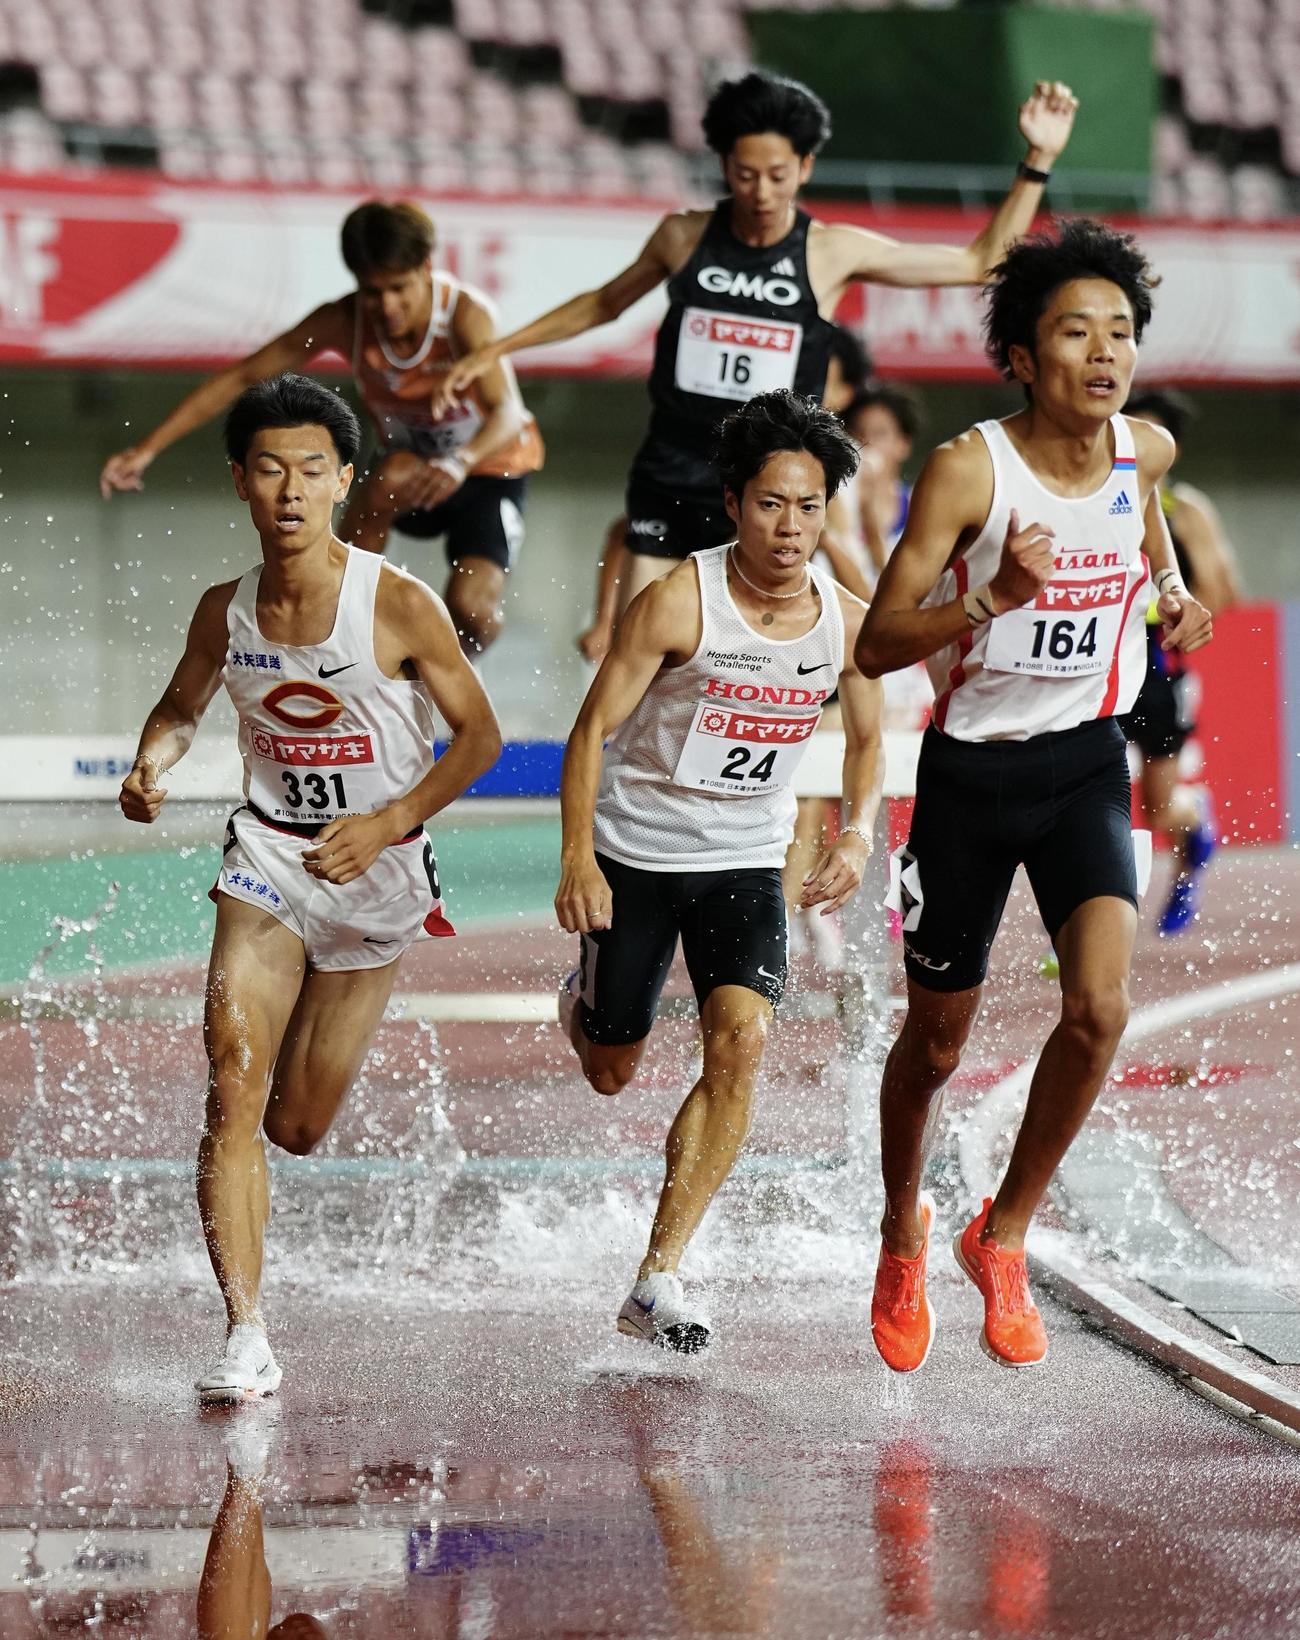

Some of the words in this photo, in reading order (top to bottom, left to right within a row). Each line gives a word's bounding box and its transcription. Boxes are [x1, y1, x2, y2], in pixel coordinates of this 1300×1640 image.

[697, 265, 801, 307] GMO
[714, 320, 790, 349] ヤマザキ
[719, 352, 752, 385] 16
[1108, 505, 1133, 516] adidas
[1054, 547, 1123, 570] isan
[1043, 579, 1123, 606] ヤマザキ
[1031, 616, 1098, 660] 164
[233, 651, 282, 670] 大矢運送
[706, 650, 738, 661] Honda
[738, 653, 772, 664] Sports
[713, 660, 762, 672] Challenge
[703, 679, 827, 705] HONDA
[734, 719, 815, 739] ヤマザキ
[276, 741, 366, 761] ヤマザキ
[719, 746, 778, 783] 24
[281, 770, 347, 810] 331
